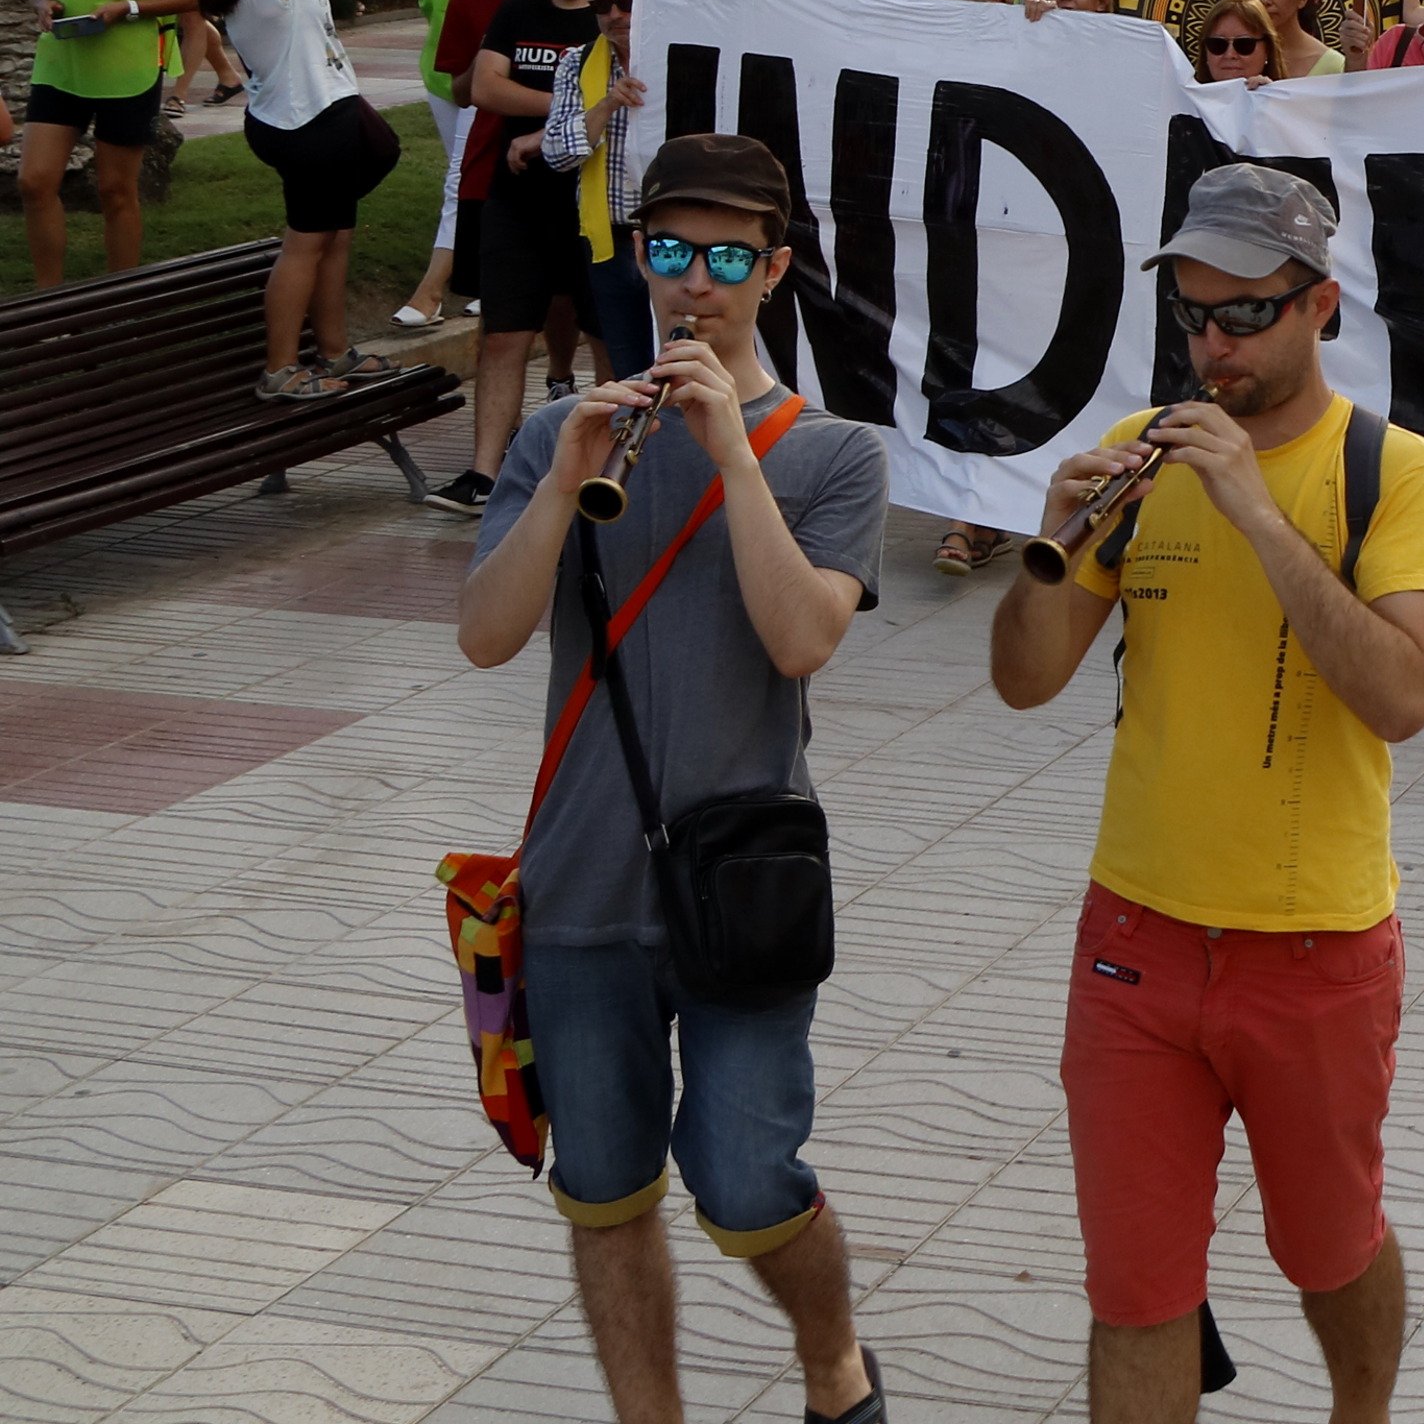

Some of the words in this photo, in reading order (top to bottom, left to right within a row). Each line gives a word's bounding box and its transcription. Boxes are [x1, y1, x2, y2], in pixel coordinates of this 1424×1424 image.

[514, 47, 558, 64] RIUD
[1279, 616, 1289, 638] llibe
[1277, 639, 1287, 650] la
[1276, 651, 1286, 664] de
[1274, 666, 1286, 690] prop
[1270, 699, 1280, 722] més
[1266, 723, 1277, 754] metre
[1262, 755, 1272, 769] Un
